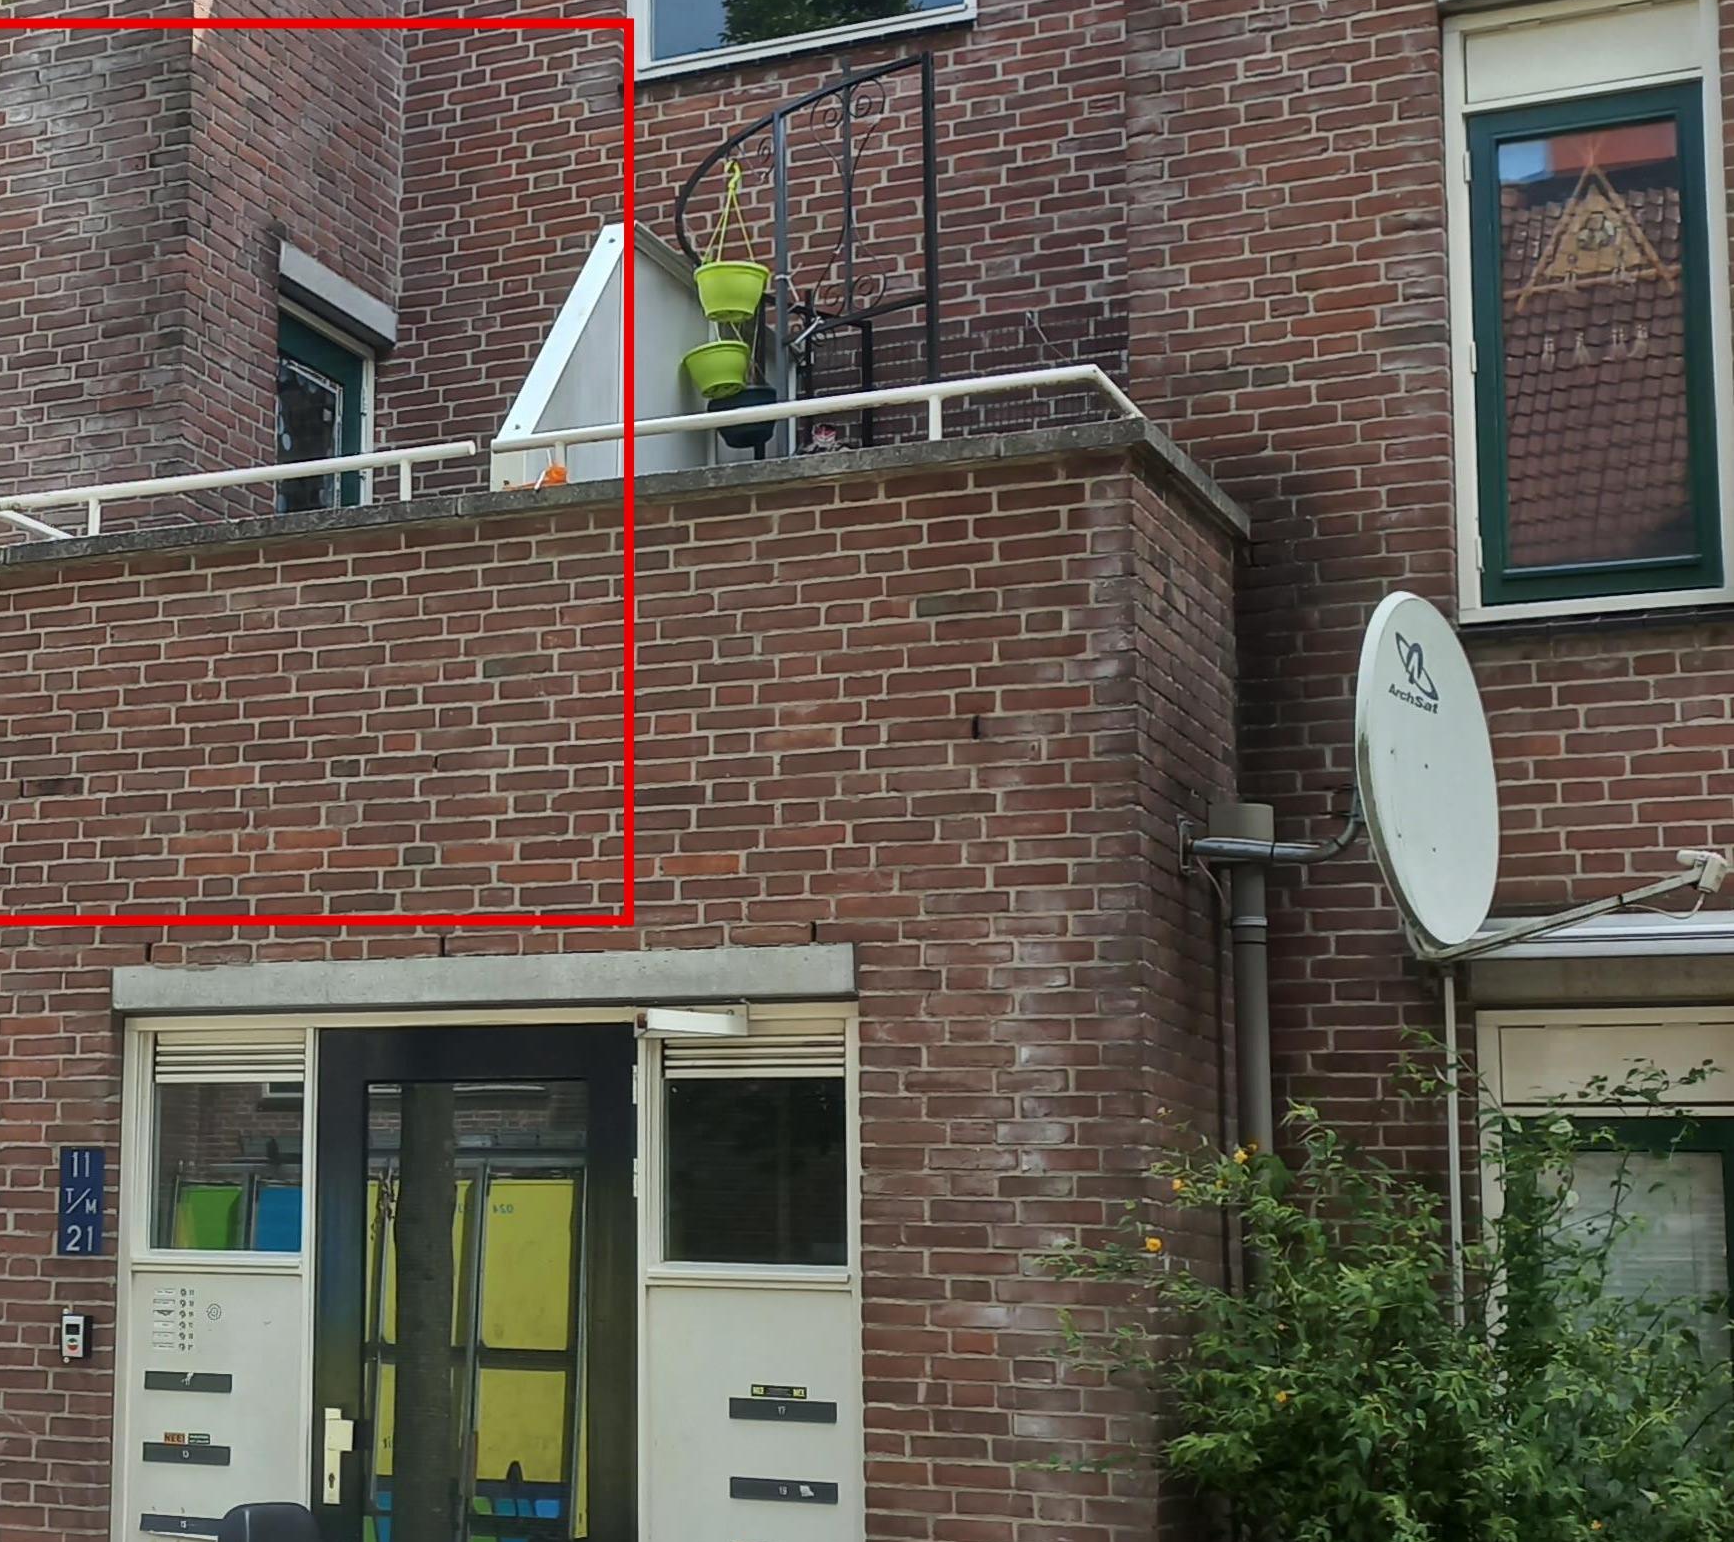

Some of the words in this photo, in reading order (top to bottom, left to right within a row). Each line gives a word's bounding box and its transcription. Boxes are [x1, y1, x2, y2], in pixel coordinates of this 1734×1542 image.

[1388, 683, 1438, 714] ArchSat
[71, 1151, 90, 1178] 11
[65, 1187, 97, 1214] T/M
[66, 1224, 94, 1252] 21
